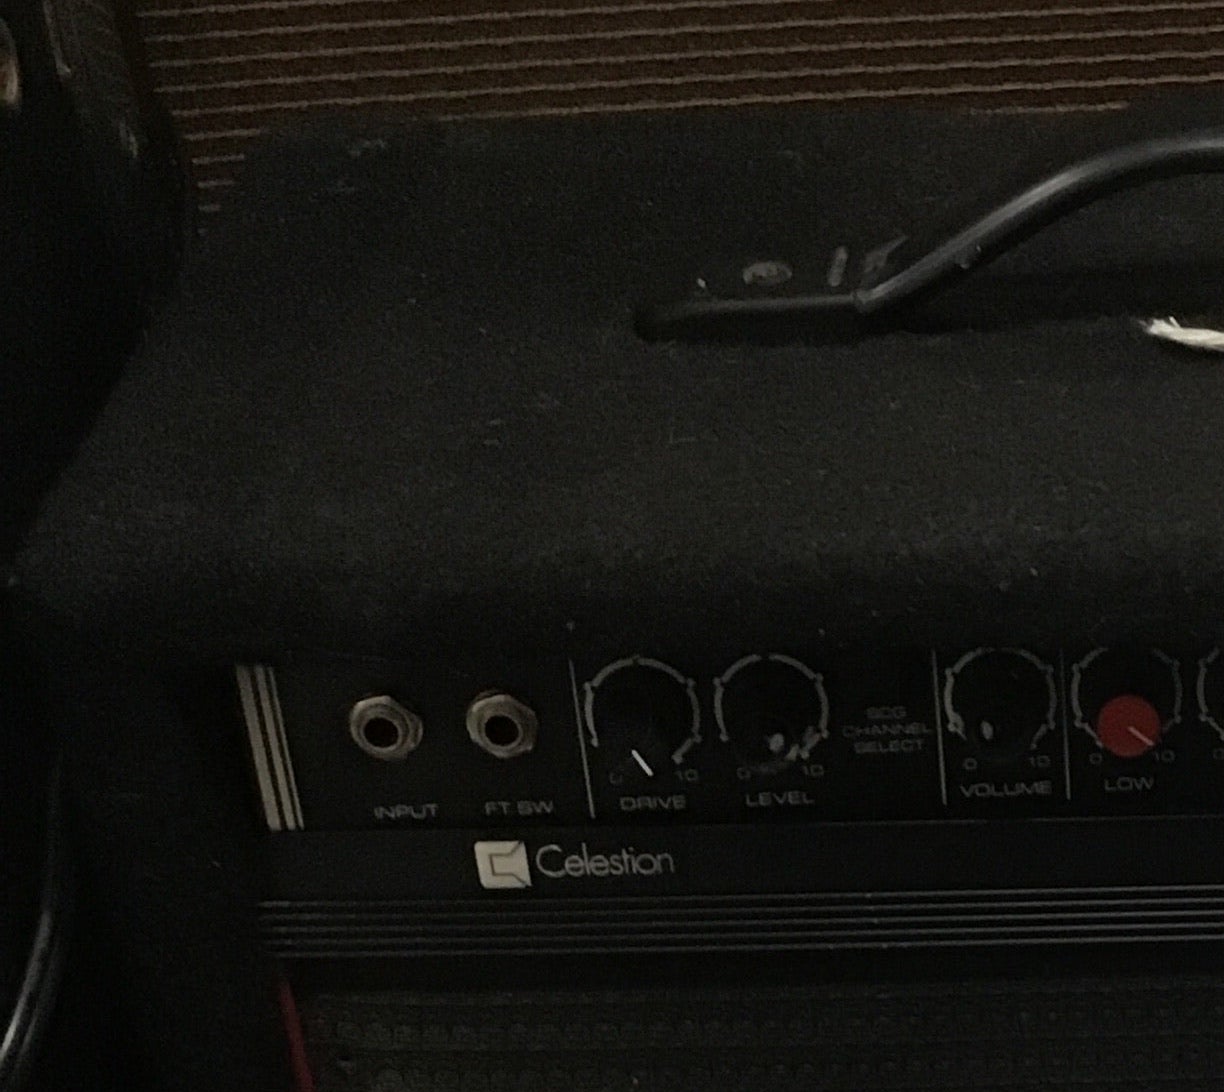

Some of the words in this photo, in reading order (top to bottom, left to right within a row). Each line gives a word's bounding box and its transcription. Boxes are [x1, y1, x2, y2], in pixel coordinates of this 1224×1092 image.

[842, 720, 932, 739] CHANNEL
[854, 738, 923, 754] SELECT
[963, 757, 977, 771] 0
[1029, 755, 1050, 768] 10
[1089, 752, 1103, 765] 0
[1154, 750, 1175, 763] 10
[676, 769, 699, 782] 10
[803, 763, 824, 777] 10
[959, 780, 1052, 798] VOLUME
[1104, 776, 1155, 792] LOW
[619, 794, 686, 811] DRIVE
[745, 790, 815, 807] LEVEL
[374, 803, 438, 819] INPUT
[485, 801, 510, 815] FT
[535, 843, 675, 878] Celestion
